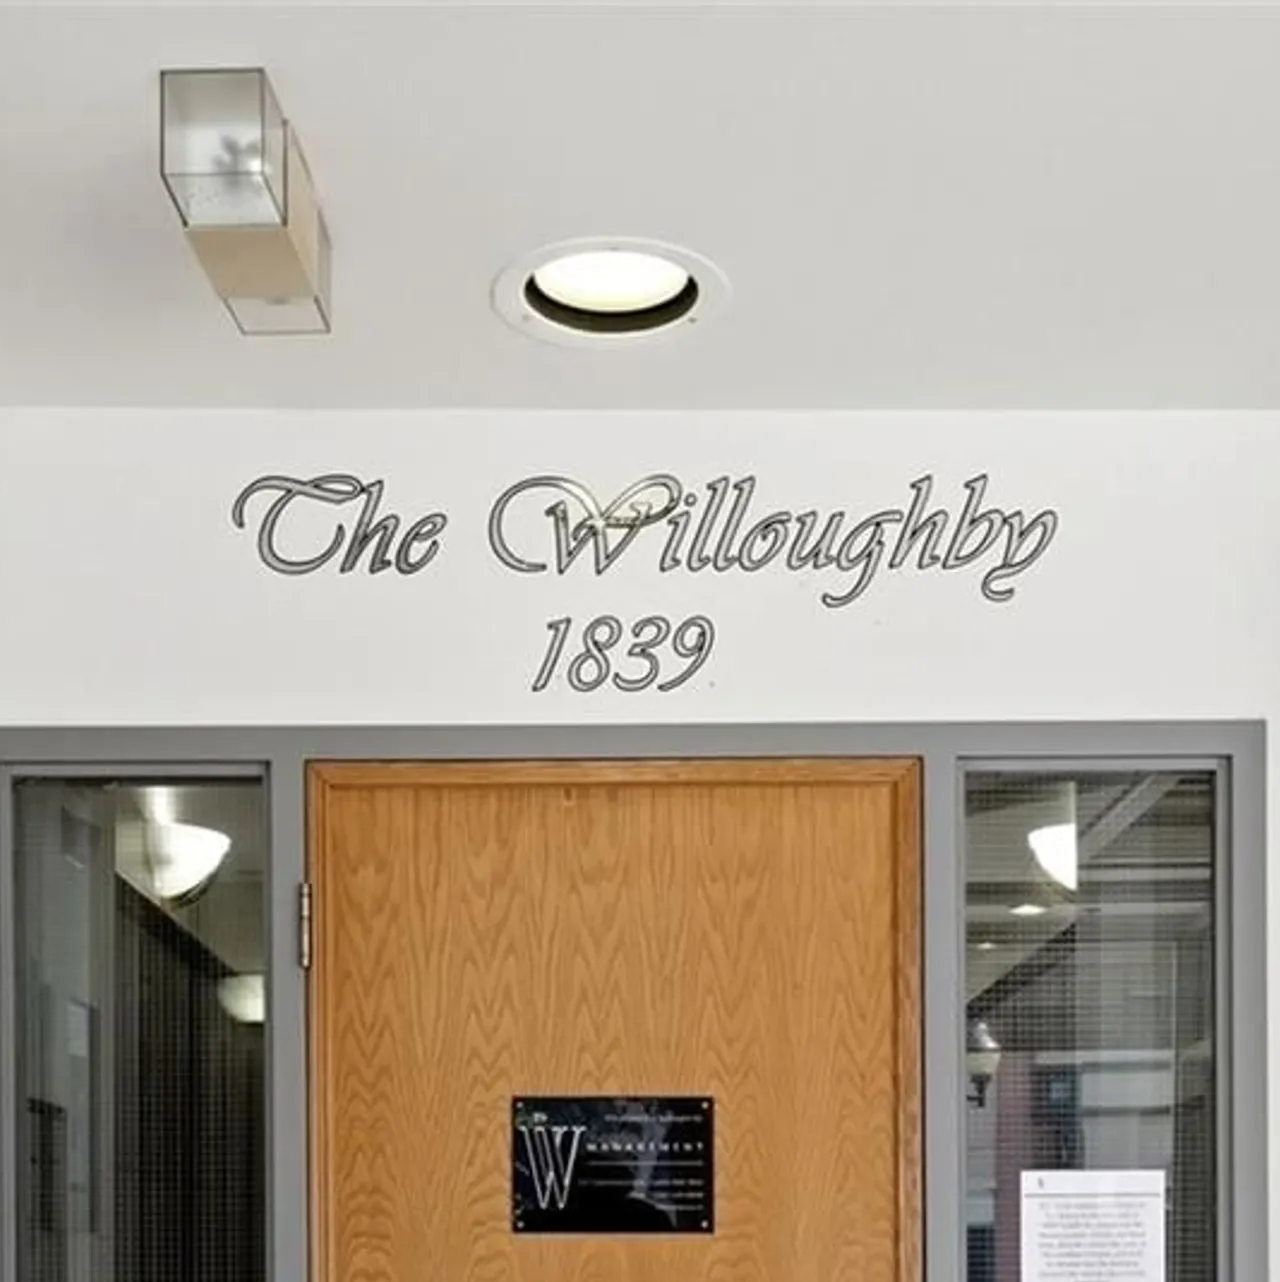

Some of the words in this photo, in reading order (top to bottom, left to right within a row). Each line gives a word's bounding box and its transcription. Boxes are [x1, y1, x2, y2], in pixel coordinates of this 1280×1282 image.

[231, 473, 448, 577] The
[488, 472, 1060, 608] Willoughby
[531, 613, 716, 693] 1839
